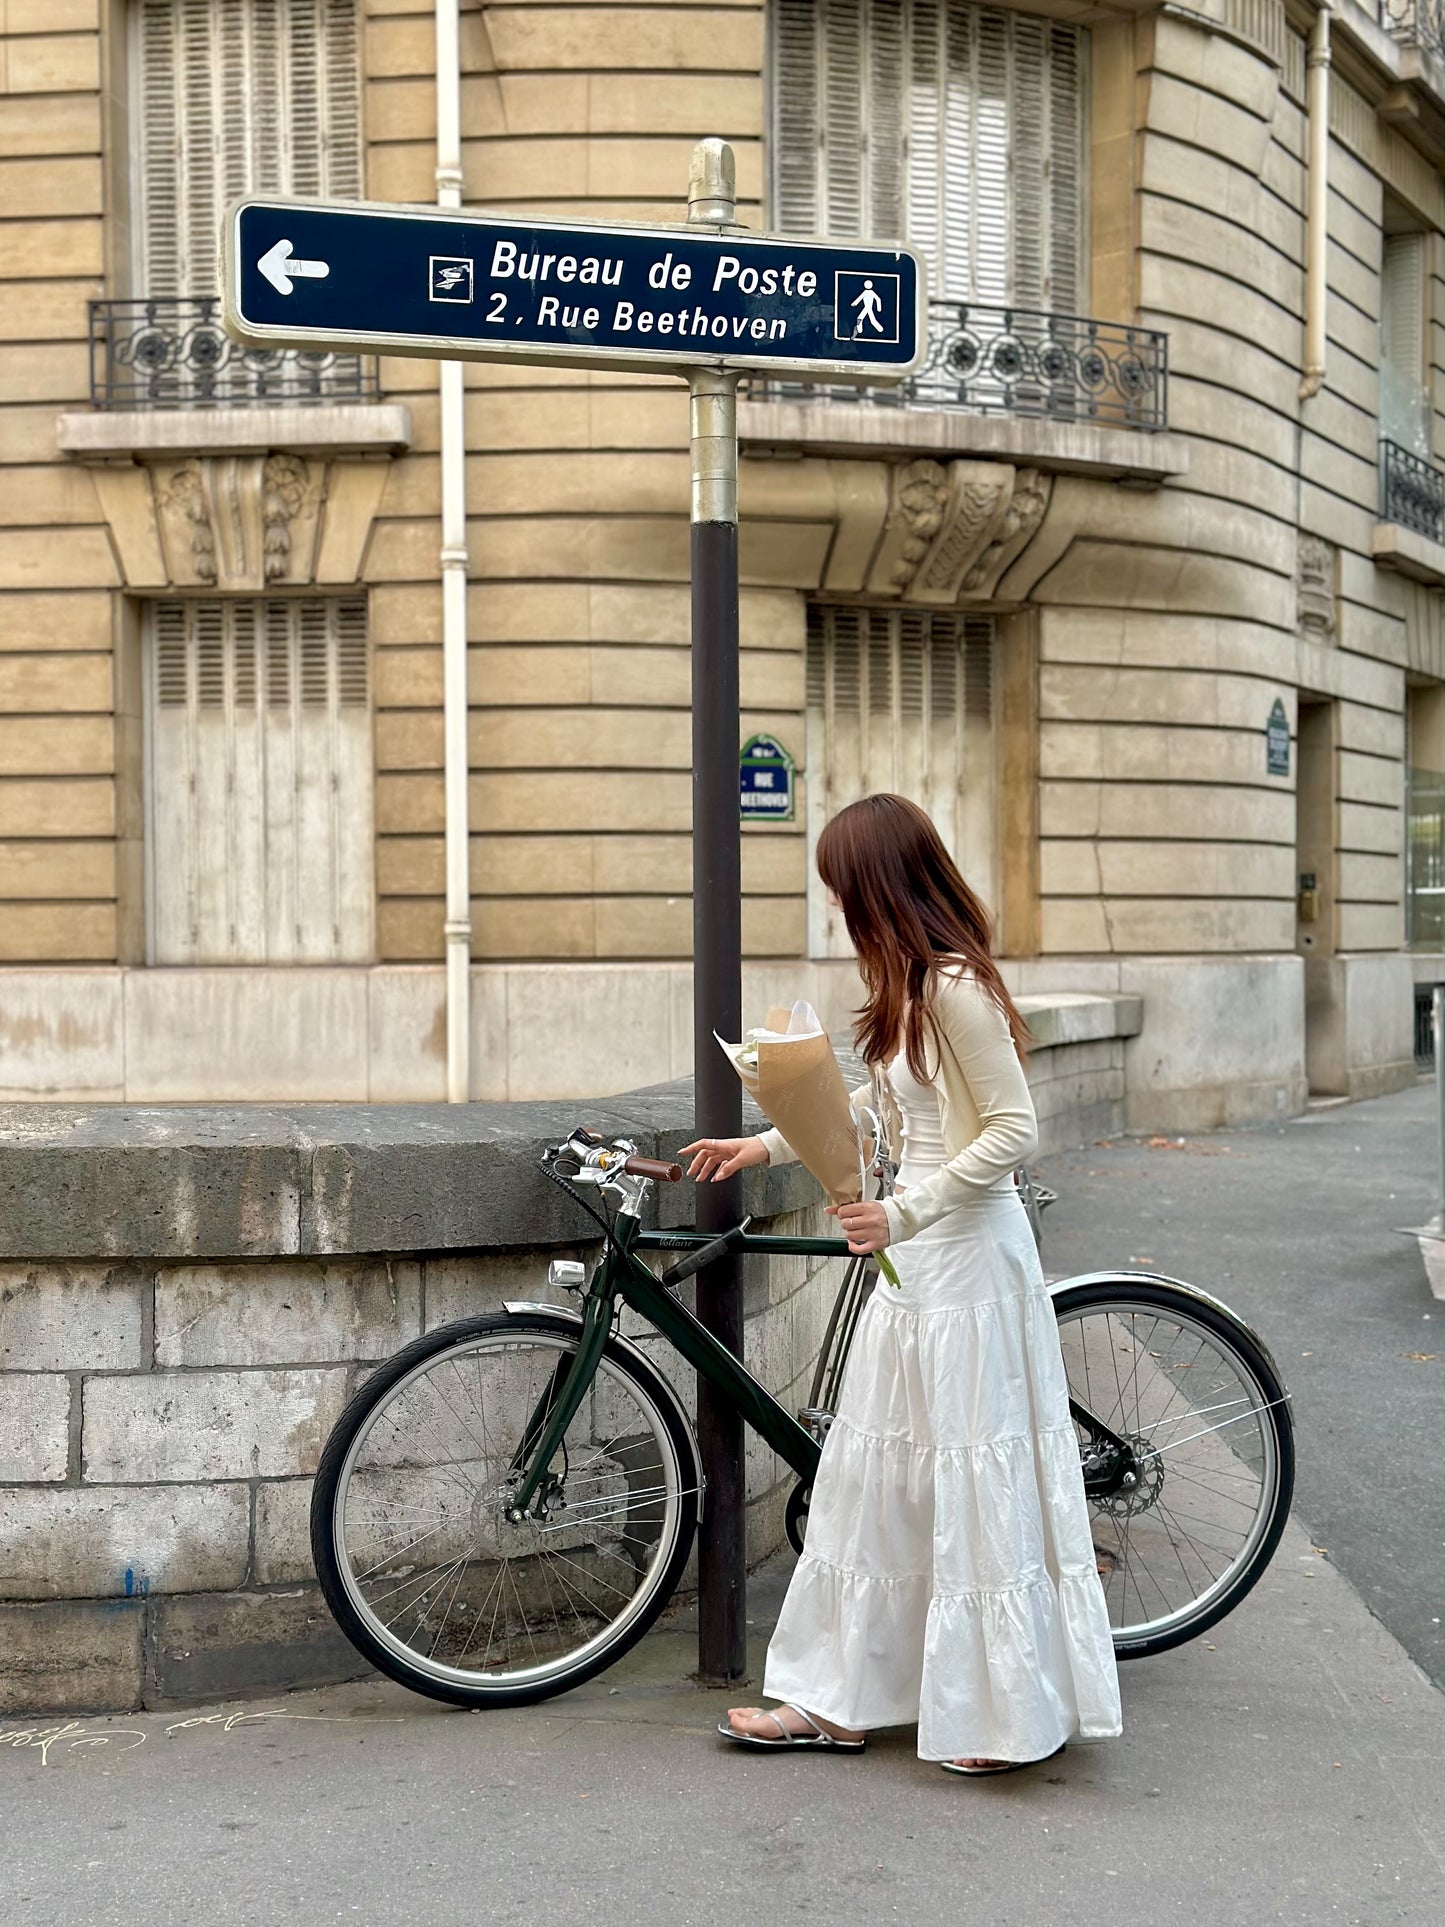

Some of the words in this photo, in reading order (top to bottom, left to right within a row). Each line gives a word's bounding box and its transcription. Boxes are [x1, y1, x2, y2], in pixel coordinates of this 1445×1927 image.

[490, 240, 624, 286] Bureau
[648, 252, 692, 290] de
[712, 255, 818, 298] Poste
[537, 296, 600, 329] Rue
[612, 301, 788, 340] Beethoven
[659, 1237, 693, 1247] Voltaire
